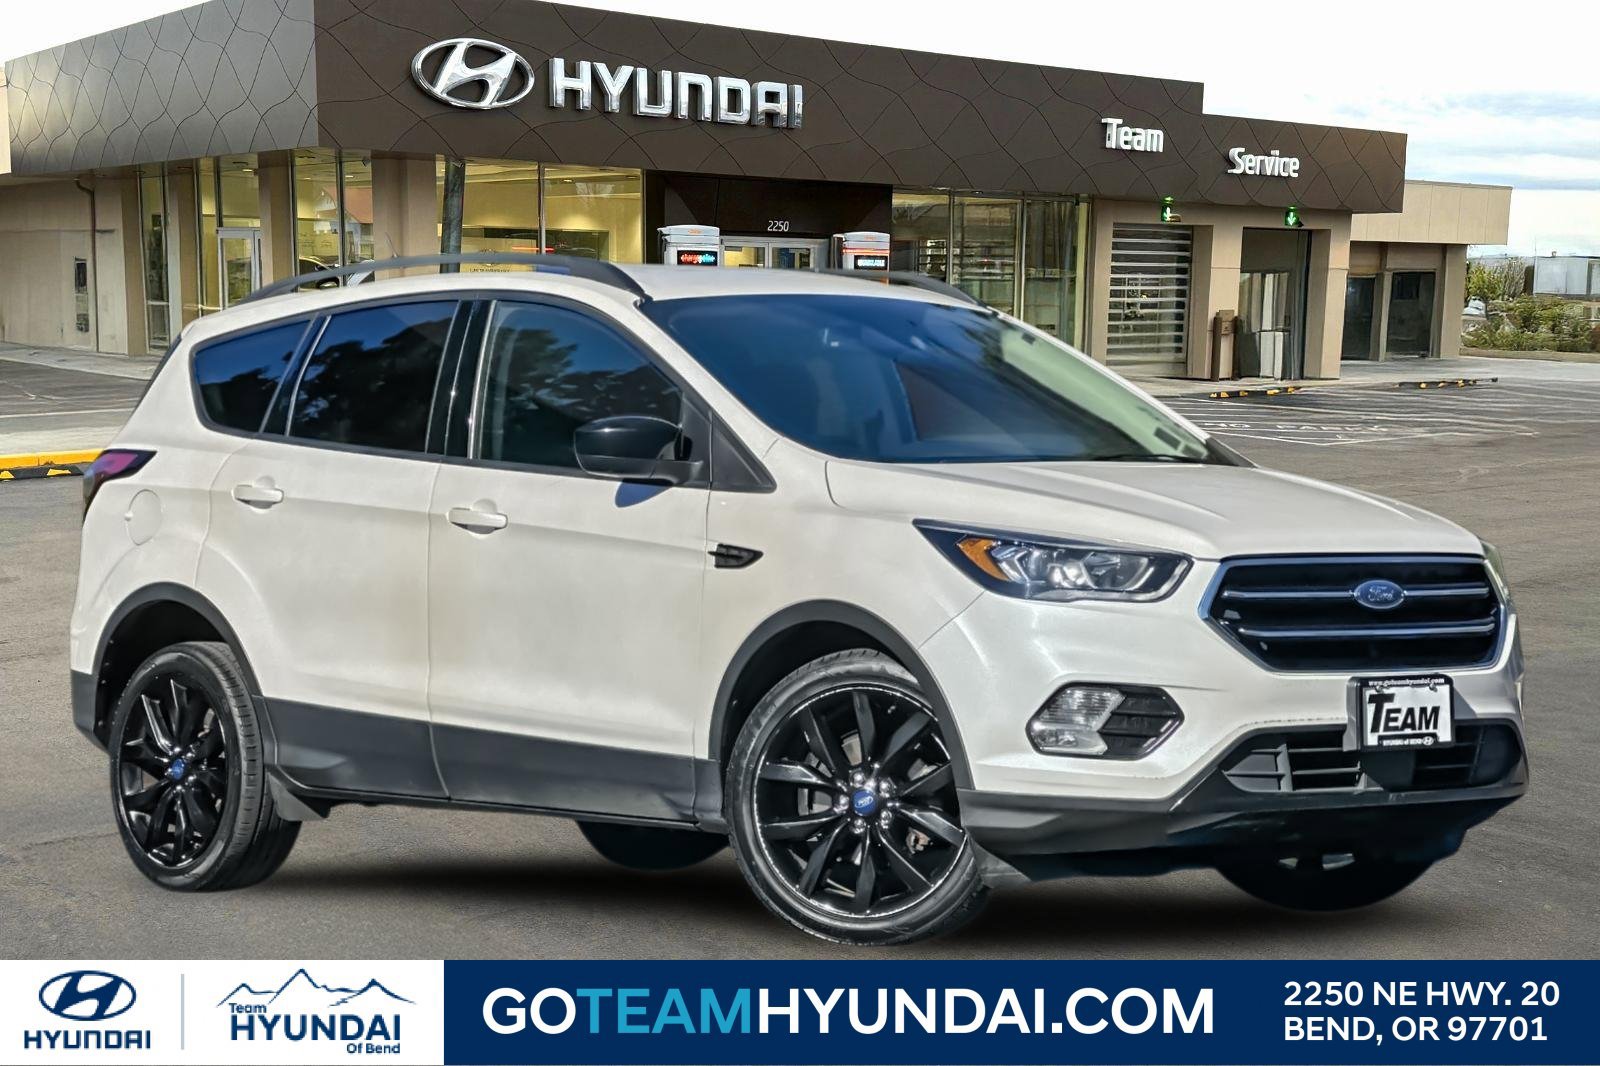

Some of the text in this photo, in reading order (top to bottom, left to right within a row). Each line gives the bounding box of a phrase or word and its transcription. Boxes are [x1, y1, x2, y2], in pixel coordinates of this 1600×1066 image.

[549, 57, 803, 129] HYUNDAI
[1102, 117, 1164, 153] Team
[1227, 147, 1300, 178] Service
[767, 220, 790, 232] 2250
[1367, 693, 1441, 733] TEAM
